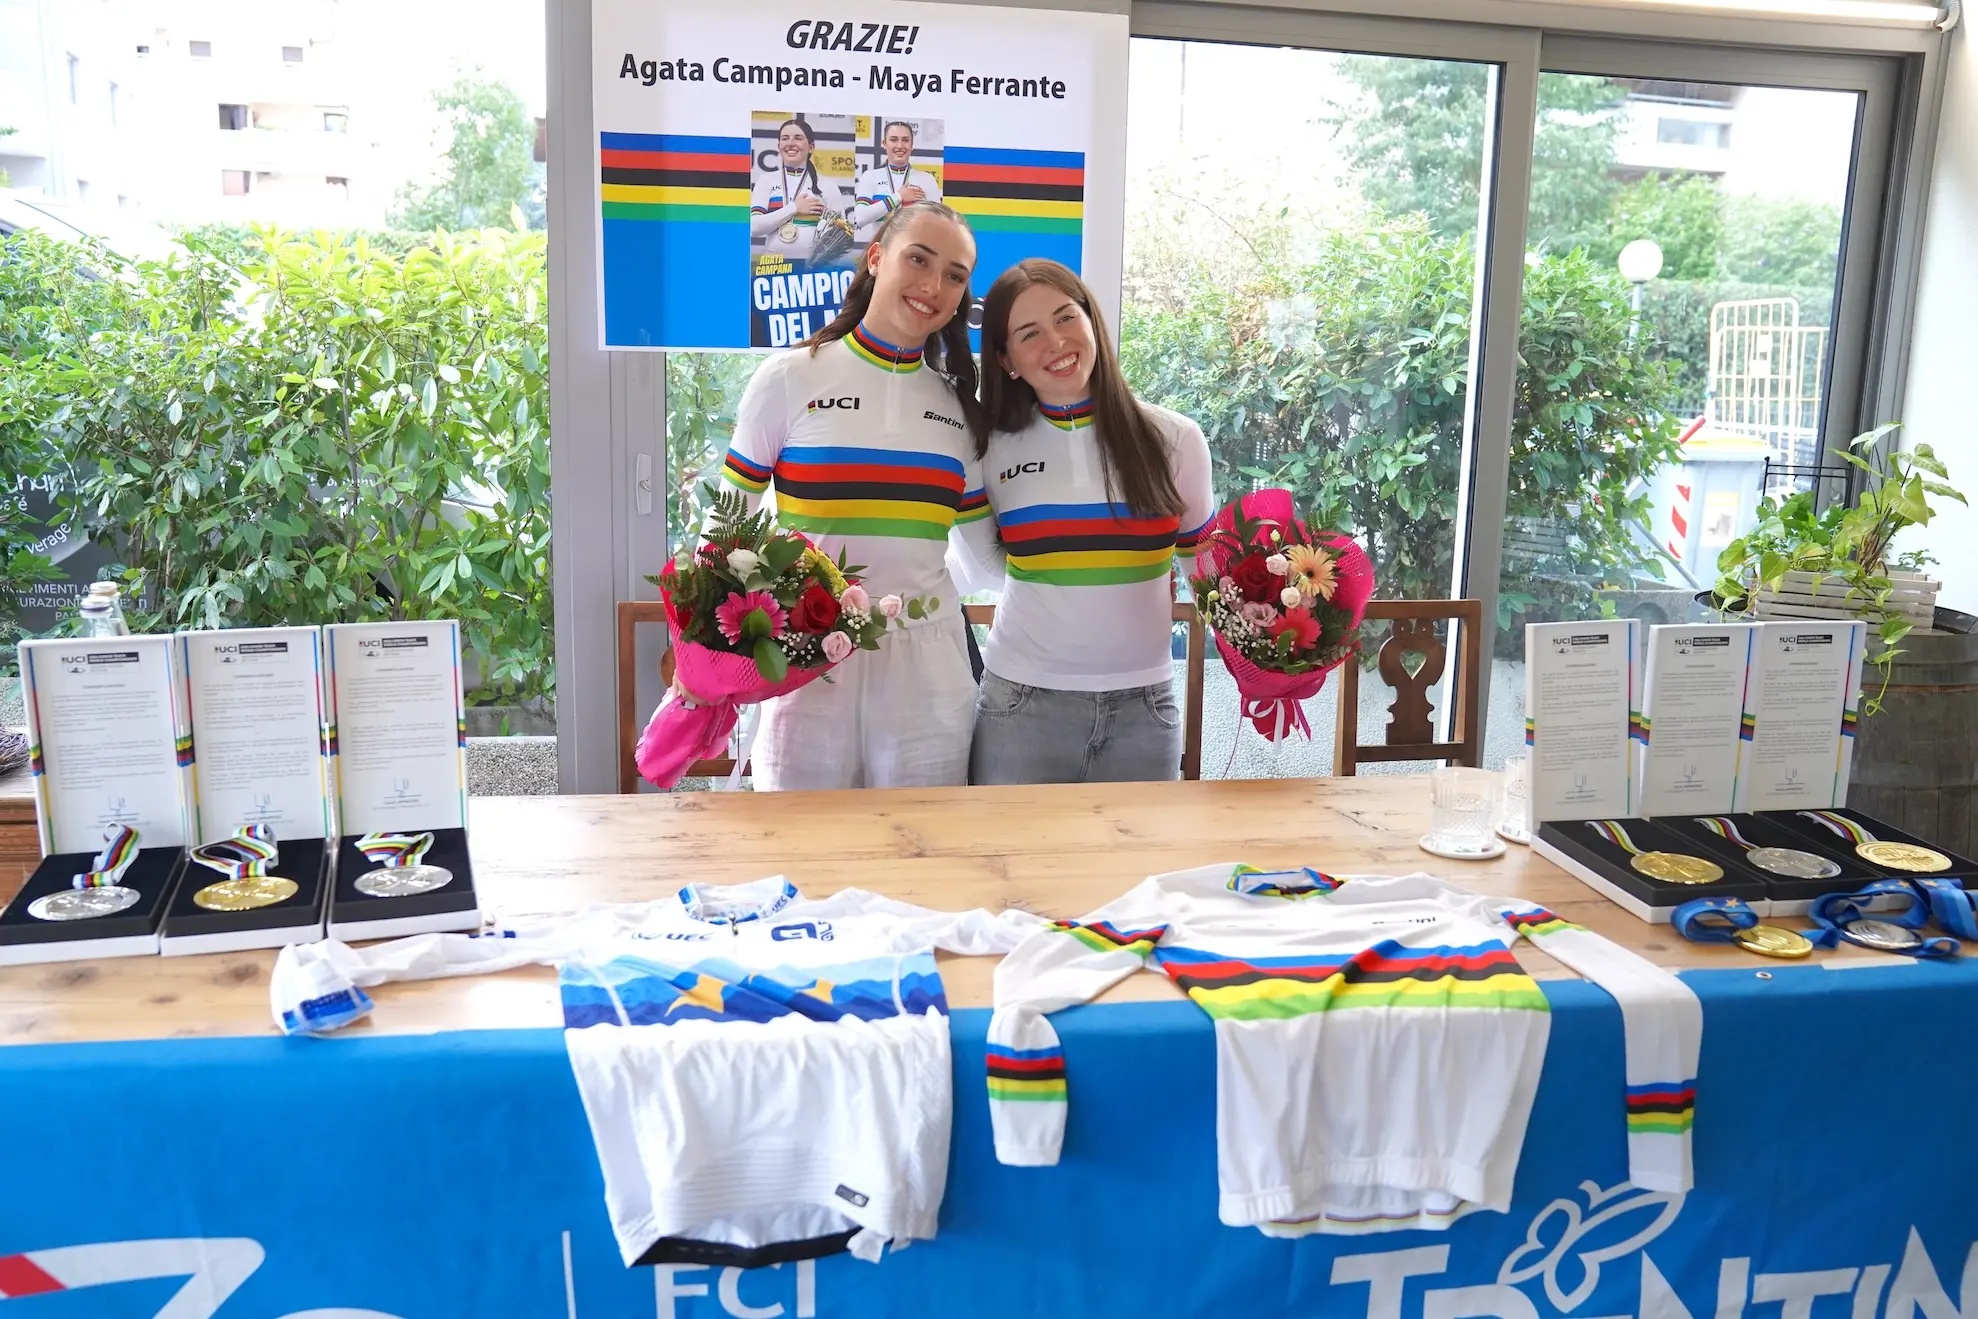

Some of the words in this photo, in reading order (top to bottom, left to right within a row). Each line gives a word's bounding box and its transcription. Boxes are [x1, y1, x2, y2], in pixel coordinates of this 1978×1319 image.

[786, 20, 919, 54] GRAZIE!
[619, 54, 704, 86] Agata
[712, 57, 844, 91] Campana
[868, 65, 942, 99] Maya
[951, 69, 1066, 99] Ferrante
[831, 157, 855, 166] SPO
[760, 254, 784, 265] AGATA
[755, 263, 793, 276] CAMPANA
[818, 397, 860, 410] UCI
[923, 410, 965, 430] Santini
[1007, 461, 1045, 480] UCI
